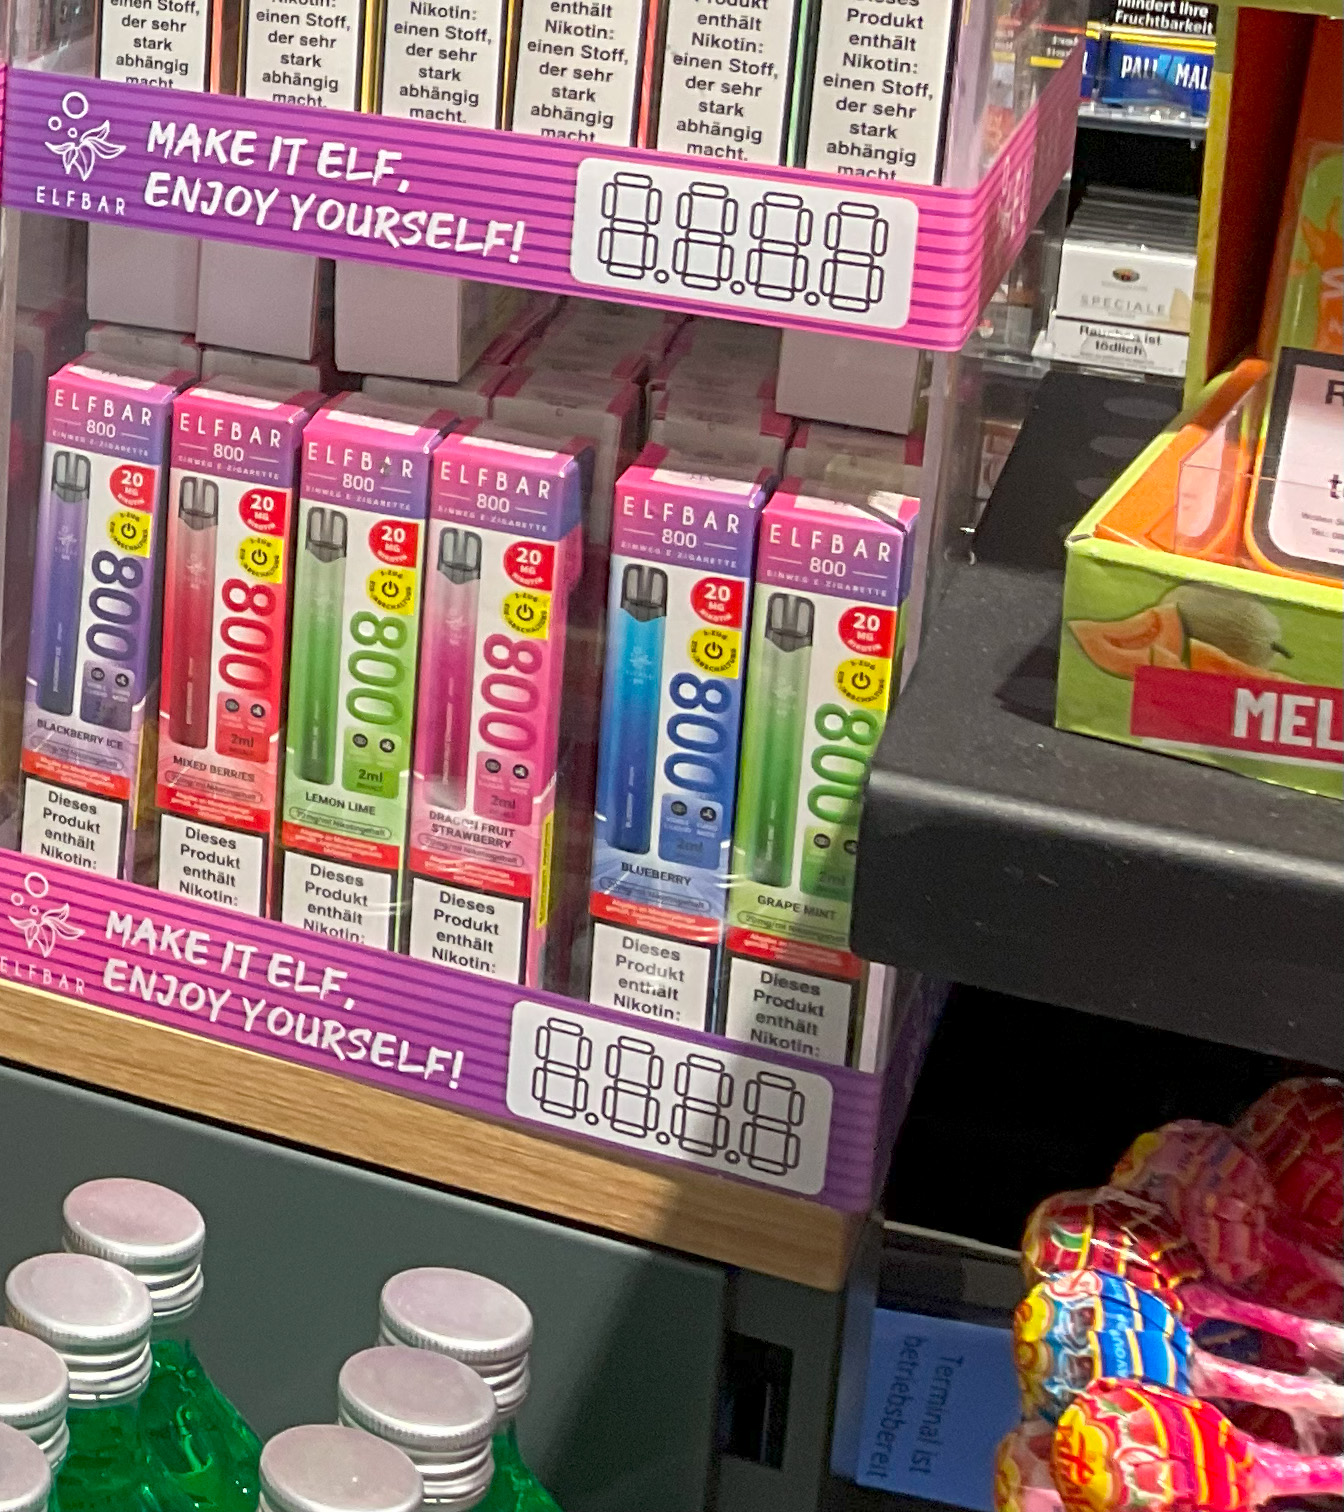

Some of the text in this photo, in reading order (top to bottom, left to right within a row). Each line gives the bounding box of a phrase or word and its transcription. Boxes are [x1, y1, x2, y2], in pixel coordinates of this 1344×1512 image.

[256, 8, 351, 32] einen Stoff,
[1179, 0, 1208, 18] Ihre
[1115, 11, 1214, 35] Fruchtbarkeit
[268, 29, 336, 50] der sehr
[280, 51, 322, 69] stark
[262, 69, 339, 94] abhängig
[145, 120, 410, 194] MAKE IT ELF,
[144, 172, 526, 263] ENJOY YOURSELF!
[1081, 293, 1168, 314] SPECIALE
[1094, 340, 1144, 358] tödlich
[172, 754, 256, 782] MIXED BERRIES
[304, 791, 376, 816] LEMON LIME
[621, 860, 692, 887] BLUEBERRY
[103, 909, 355, 1010] MAKE IT ELF,
[103, 958, 465, 1091] ENJOY YOURSELF!
[869, 1335, 923, 1479] betriebsbereit
[916, 1356, 962, 1449] Terminal
